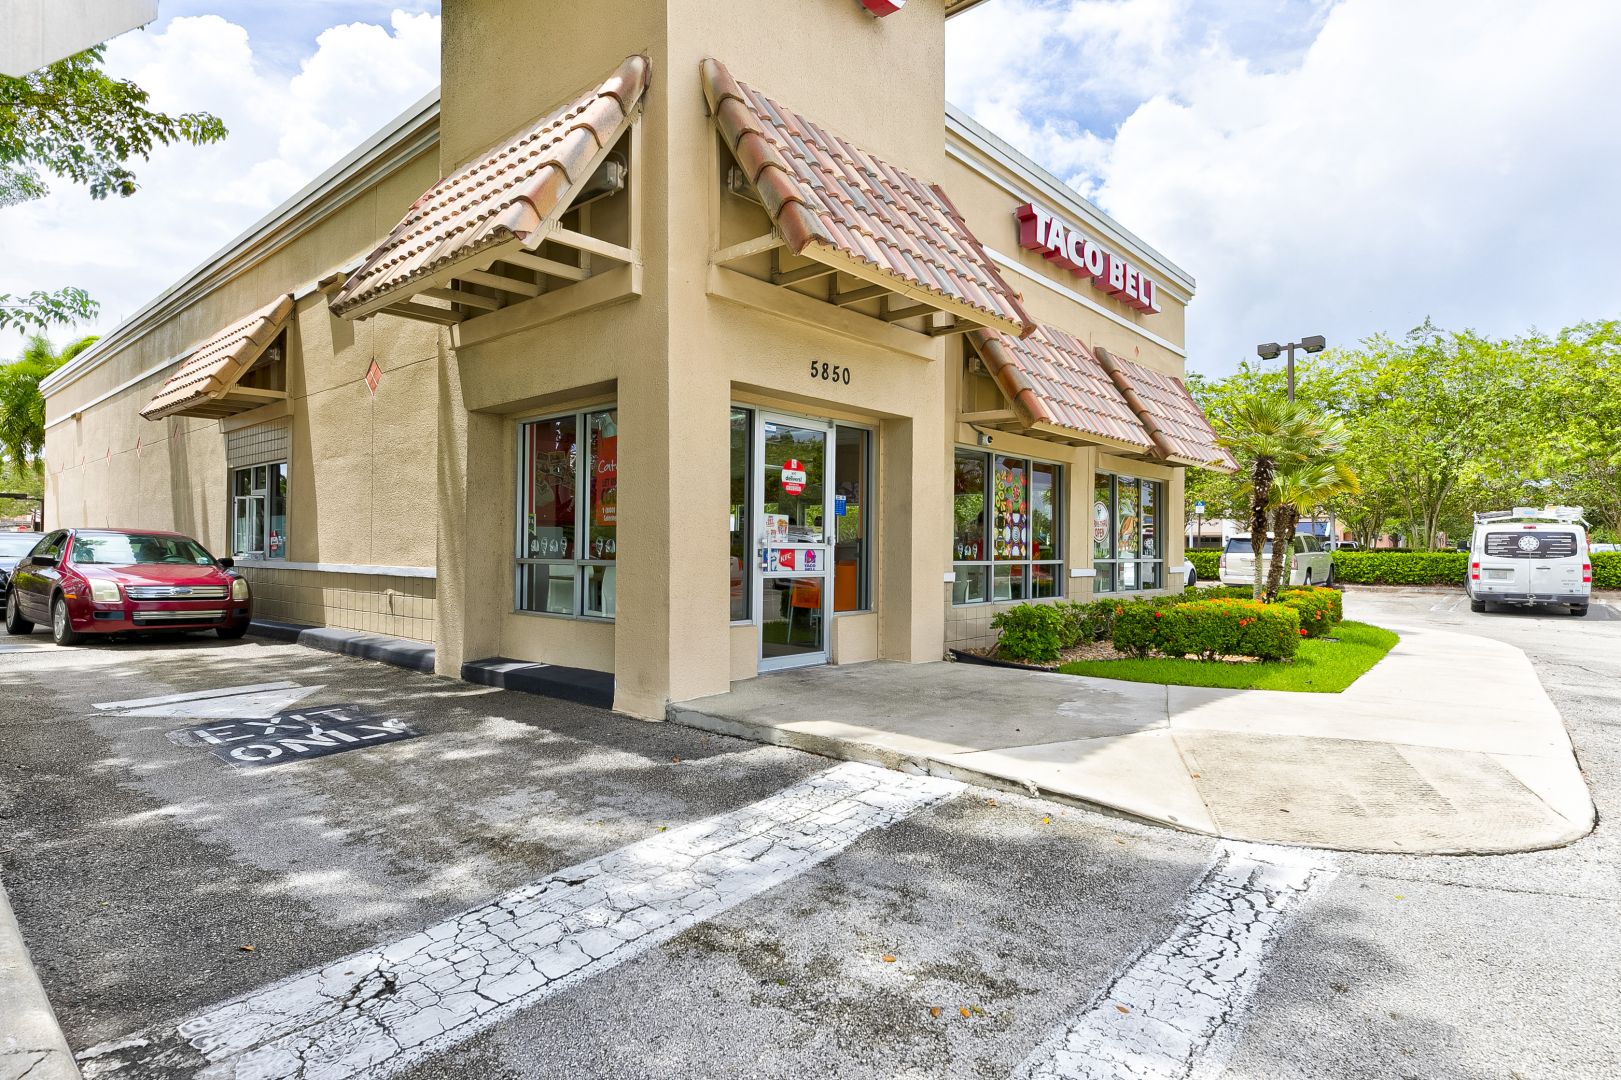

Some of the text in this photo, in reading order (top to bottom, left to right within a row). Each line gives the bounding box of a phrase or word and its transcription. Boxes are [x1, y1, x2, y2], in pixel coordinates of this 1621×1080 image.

[1025, 203, 1162, 315] TACO BELL
[810, 360, 851, 386] 5850
[597, 459, 617, 473] Cat
[780, 552, 792, 562] KFC
[194, 708, 352, 744] EXIT
